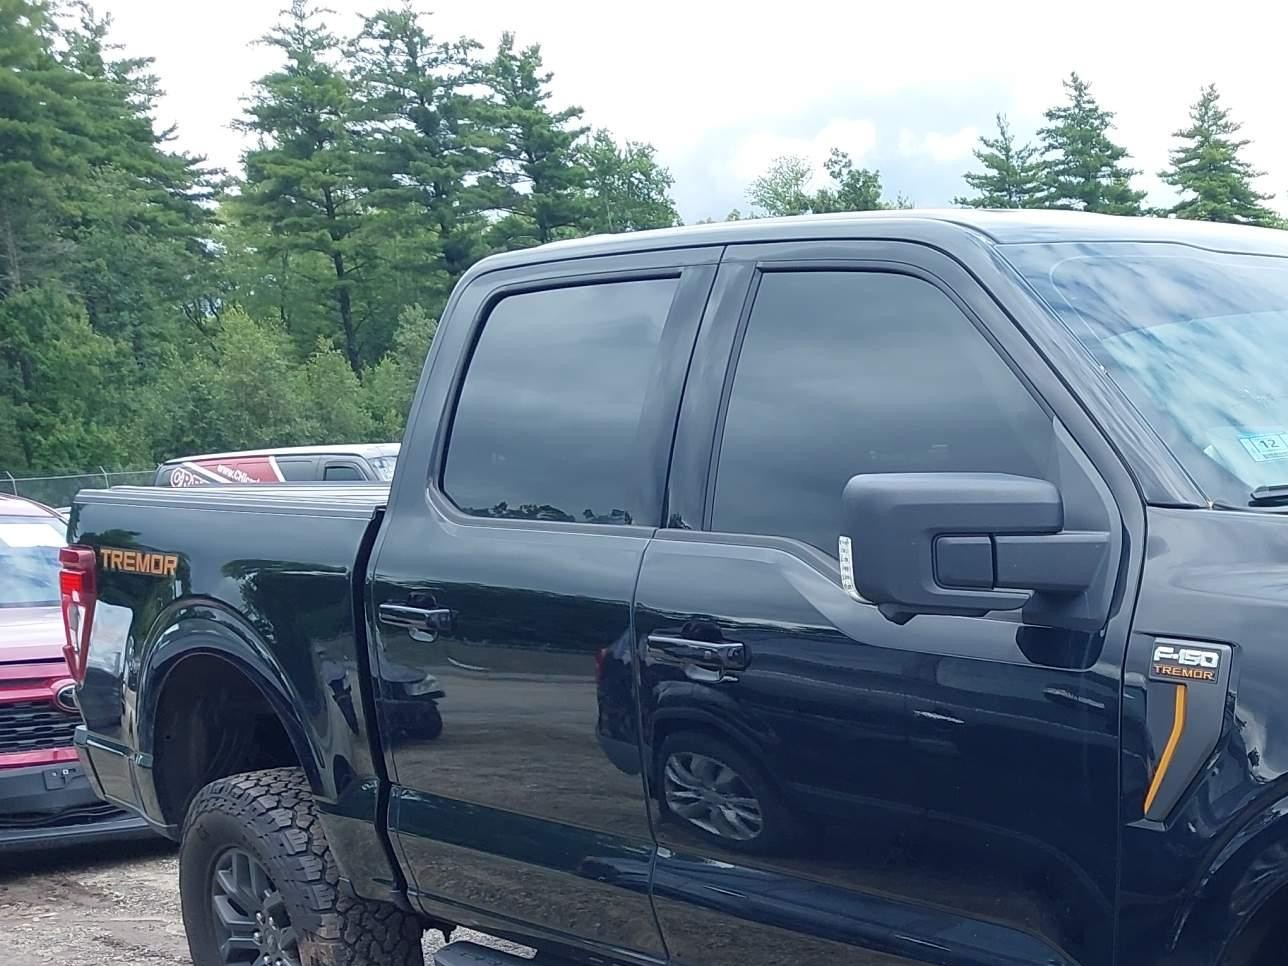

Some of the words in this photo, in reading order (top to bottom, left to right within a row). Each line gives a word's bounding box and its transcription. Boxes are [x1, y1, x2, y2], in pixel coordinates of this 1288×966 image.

[100, 548, 177, 576] TREMOR
[1153, 646, 1219, 667] F-150
[1155, 665, 1215, 681] TREMOR
